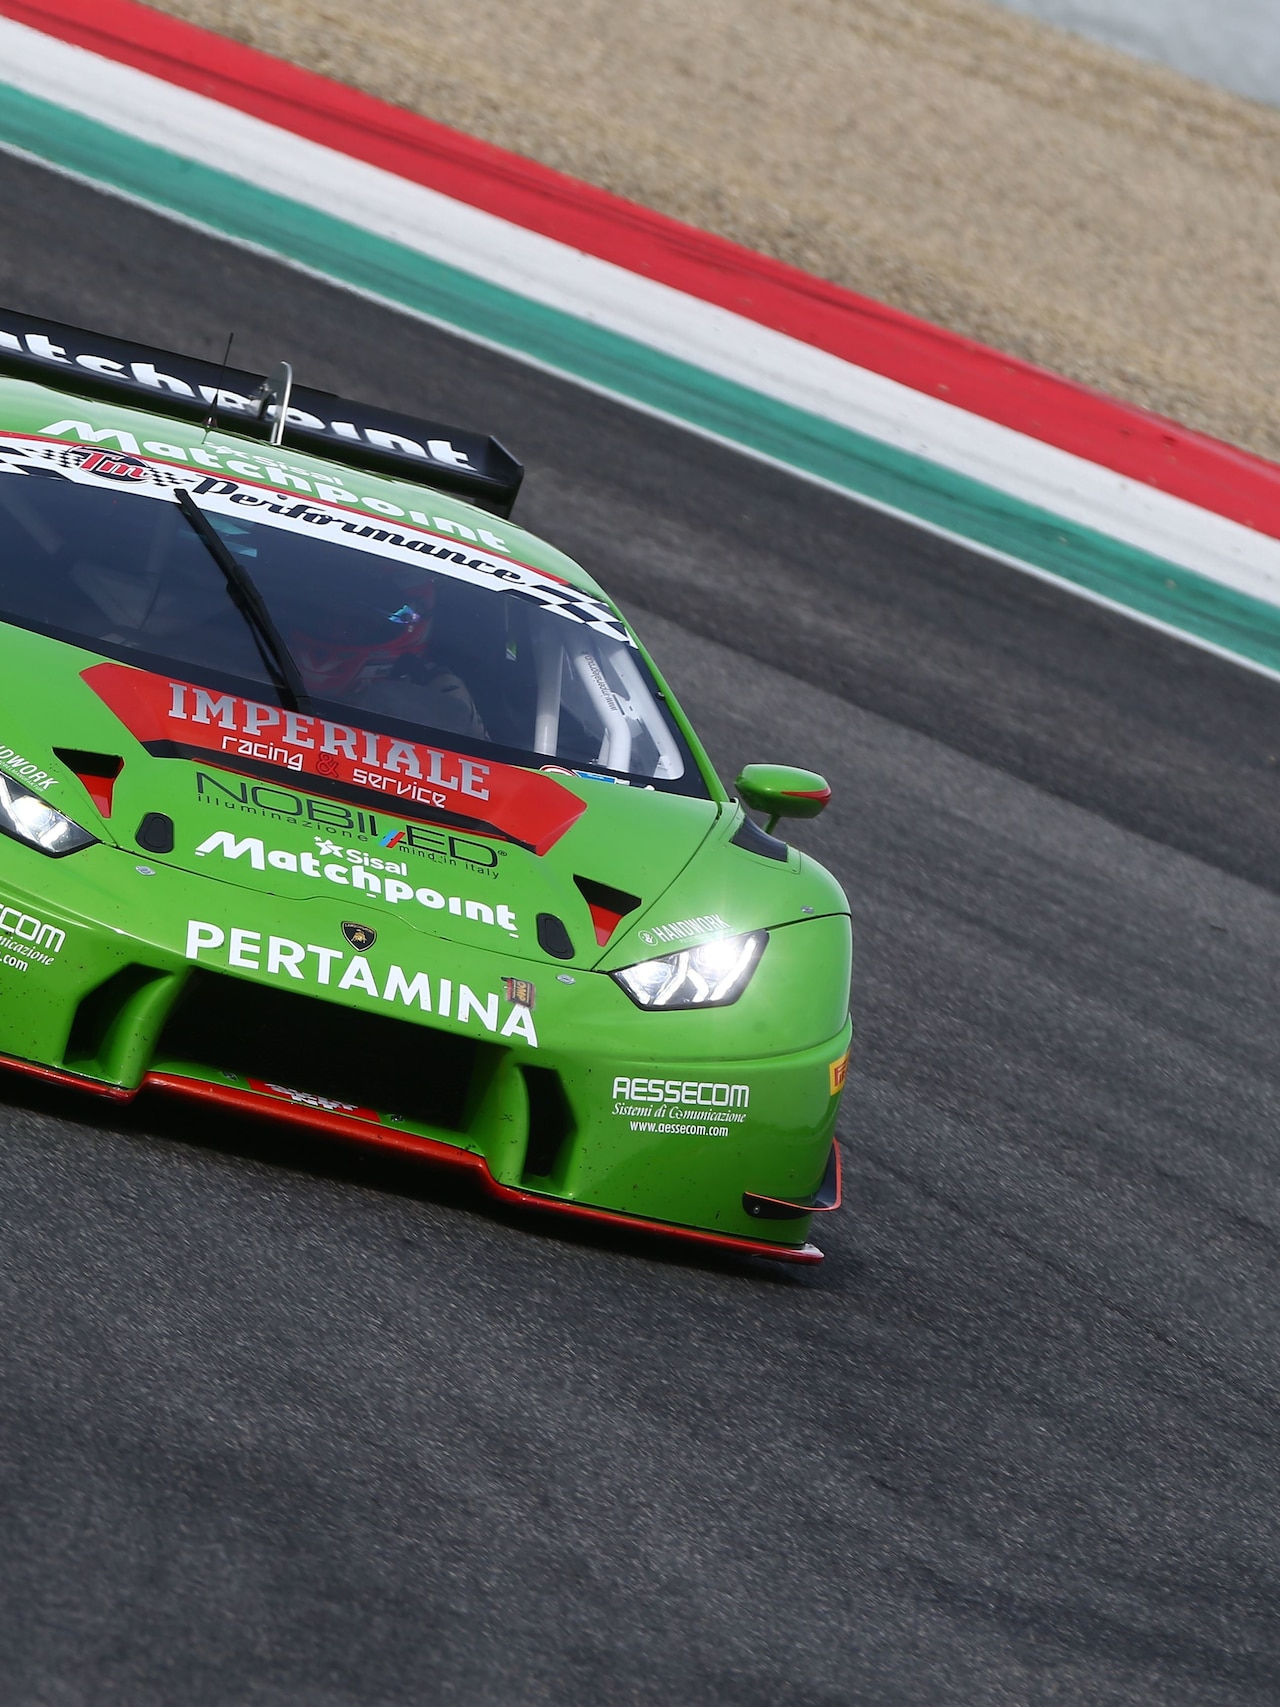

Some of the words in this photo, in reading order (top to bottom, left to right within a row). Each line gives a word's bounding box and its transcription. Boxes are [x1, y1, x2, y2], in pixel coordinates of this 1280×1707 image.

[38, 419, 511, 553] Matchpoint
[255, 456, 344, 486] Sisal
[193, 474, 526, 585] Performance
[168, 682, 490, 801] IMPERIALE
[221, 735, 304, 772] racing
[315, 753, 340, 779] &
[352, 767, 447, 809] service
[197, 794, 369, 842] illuminazione
[195, 830, 519, 934] Matchpoint
[348, 848, 408, 877] Sisal
[399, 844, 435, 861] mind
[442, 856, 457, 866] in
[465, 861, 499, 879] italy
[652, 913, 732, 943] HANDWORK
[185, 919, 538, 1048] PERTAMINA
[612, 1076, 750, 1107] AESSECOM
[612, 1102, 652, 1118] Sistemi
[654, 1104, 667, 1118] di
[669, 1105, 746, 1123] Comunicazione
[630, 1120, 729, 1137] www.aessecom.com
